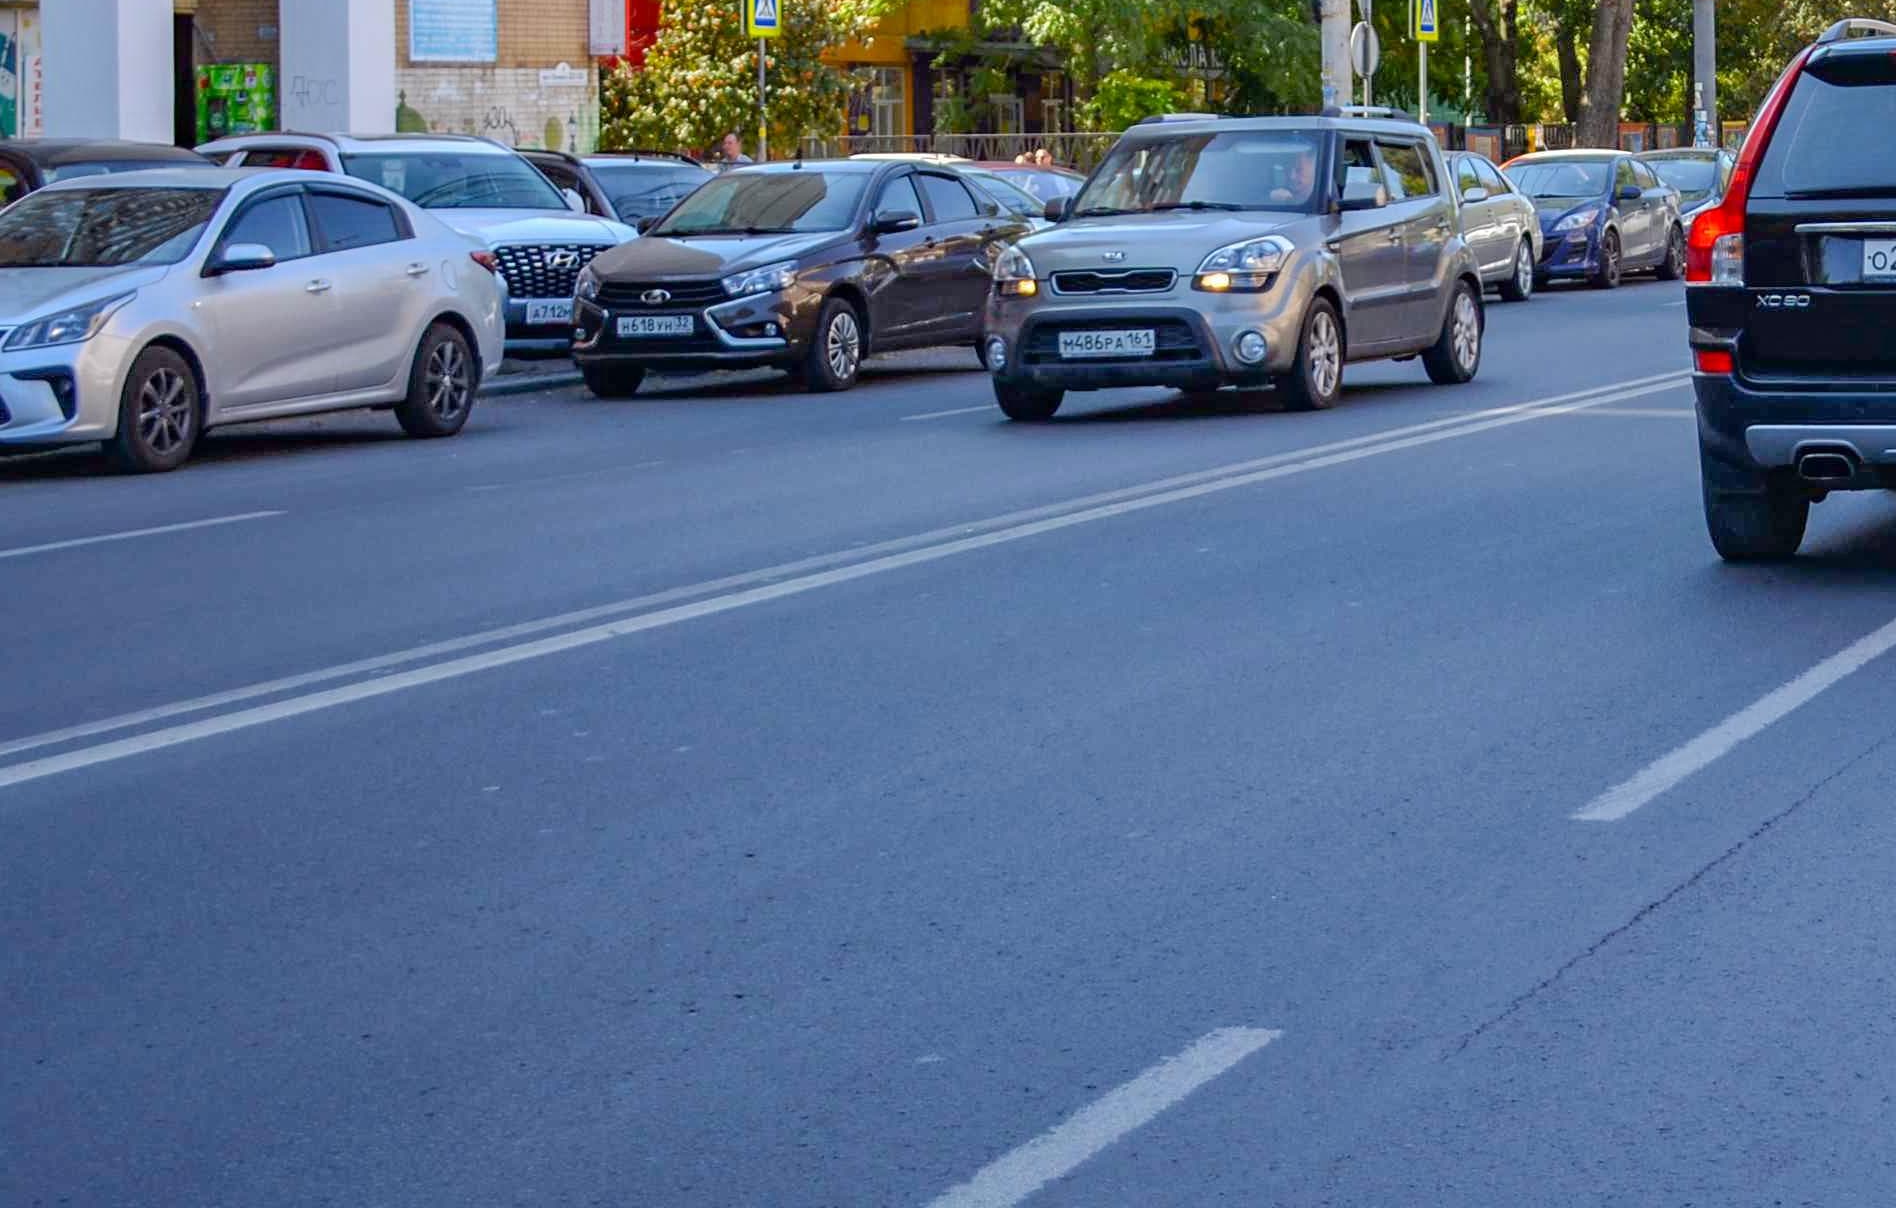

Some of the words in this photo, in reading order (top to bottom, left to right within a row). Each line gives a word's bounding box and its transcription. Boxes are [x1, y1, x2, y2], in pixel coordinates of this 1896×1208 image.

[532, 305, 571, 319] А712М
[1062, 335, 1124, 351] М486РА
[1127, 331, 1151, 345] 161
